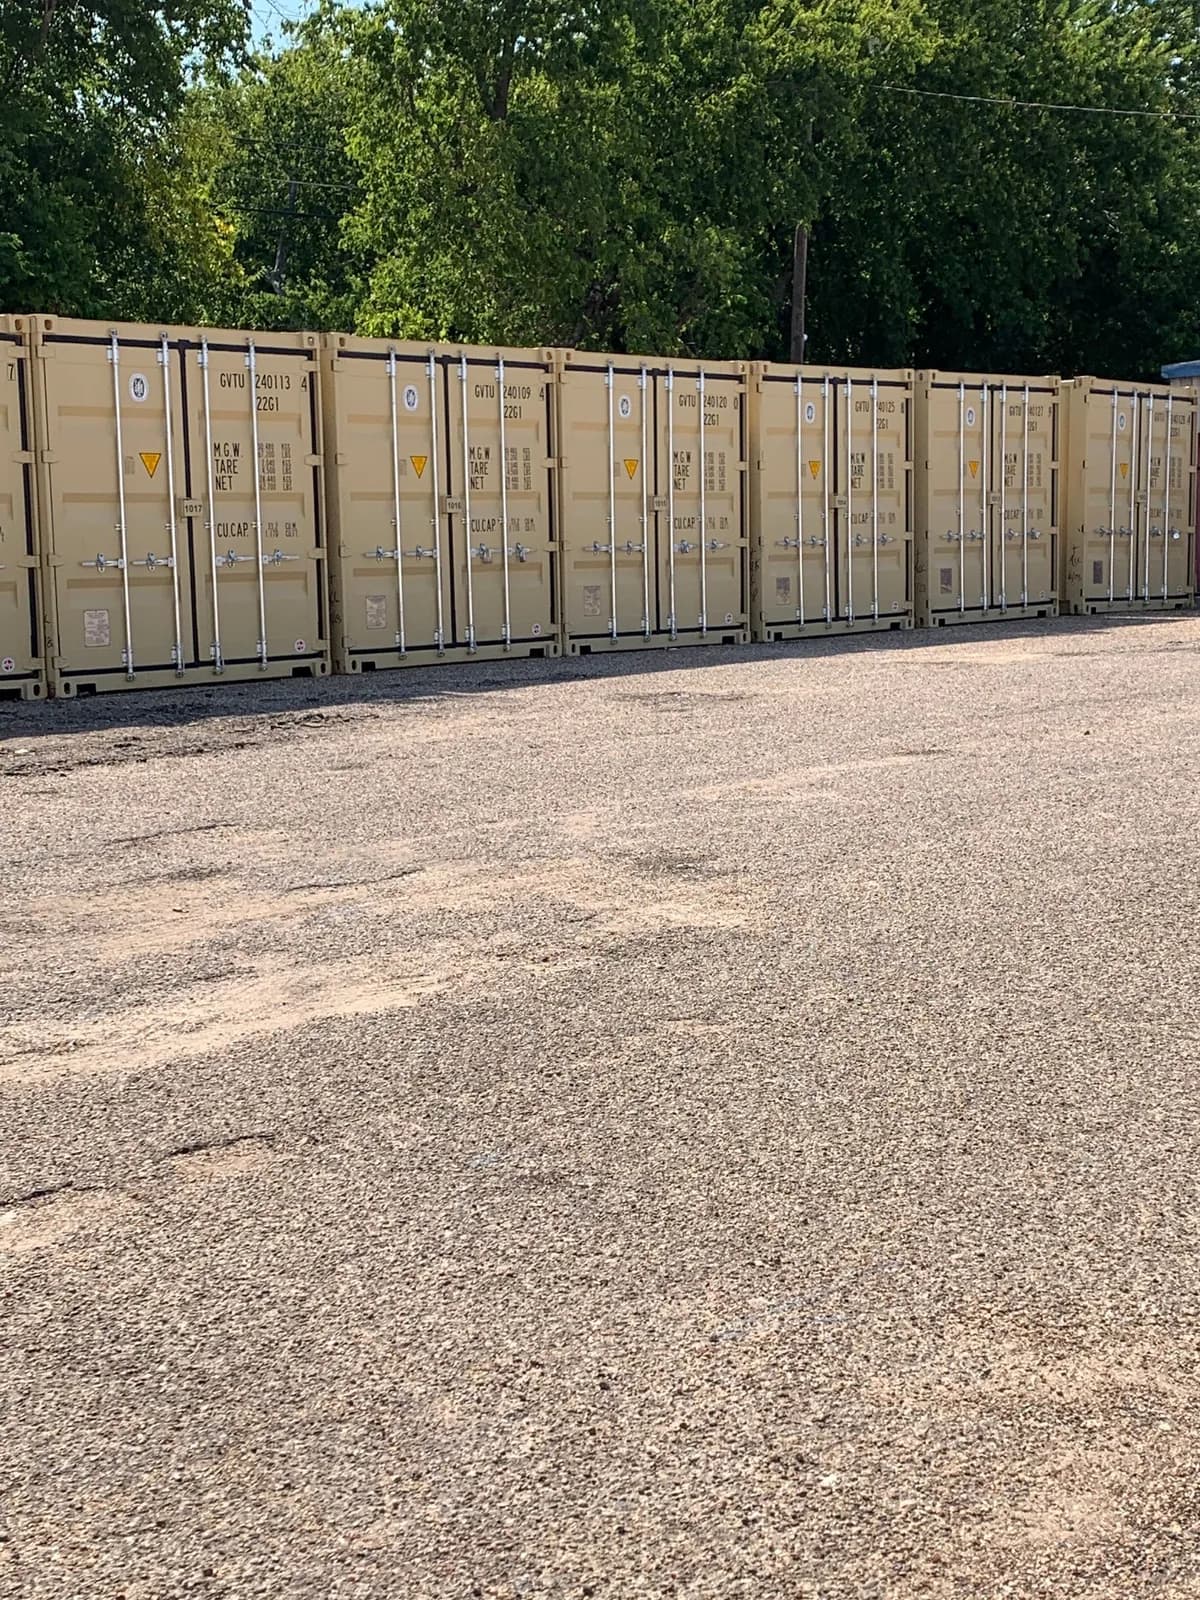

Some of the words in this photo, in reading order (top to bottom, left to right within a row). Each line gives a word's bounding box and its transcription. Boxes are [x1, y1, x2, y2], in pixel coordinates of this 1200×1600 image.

[7, 363, 15, 380] 7
[219, 373, 245, 388] GVTU
[255, 374, 291, 390] 240113
[301, 376, 307, 390] 4
[474, 384, 495, 398] GVTU
[503, 385, 531, 399] 240109
[539, 386, 545, 400] 4
[256, 396, 279, 411] 22G1
[679, 394, 696, 407] GVTU
[703, 395, 727, 408] 240120
[855, 400, 870, 412] GVTU
[876, 401, 896, 413] 40125
[503, 405, 522, 418] 22G1
[703, 413, 719, 426] 22G1
[214, 459, 239, 474] TARE
[470, 461, 488, 475] TARE
[674, 464, 690, 477] TARE
[215, 475, 233, 491] NET
[470, 476, 484, 490] NET
[673, 478, 686, 490] NET
[185, 504, 202, 512] 1017
